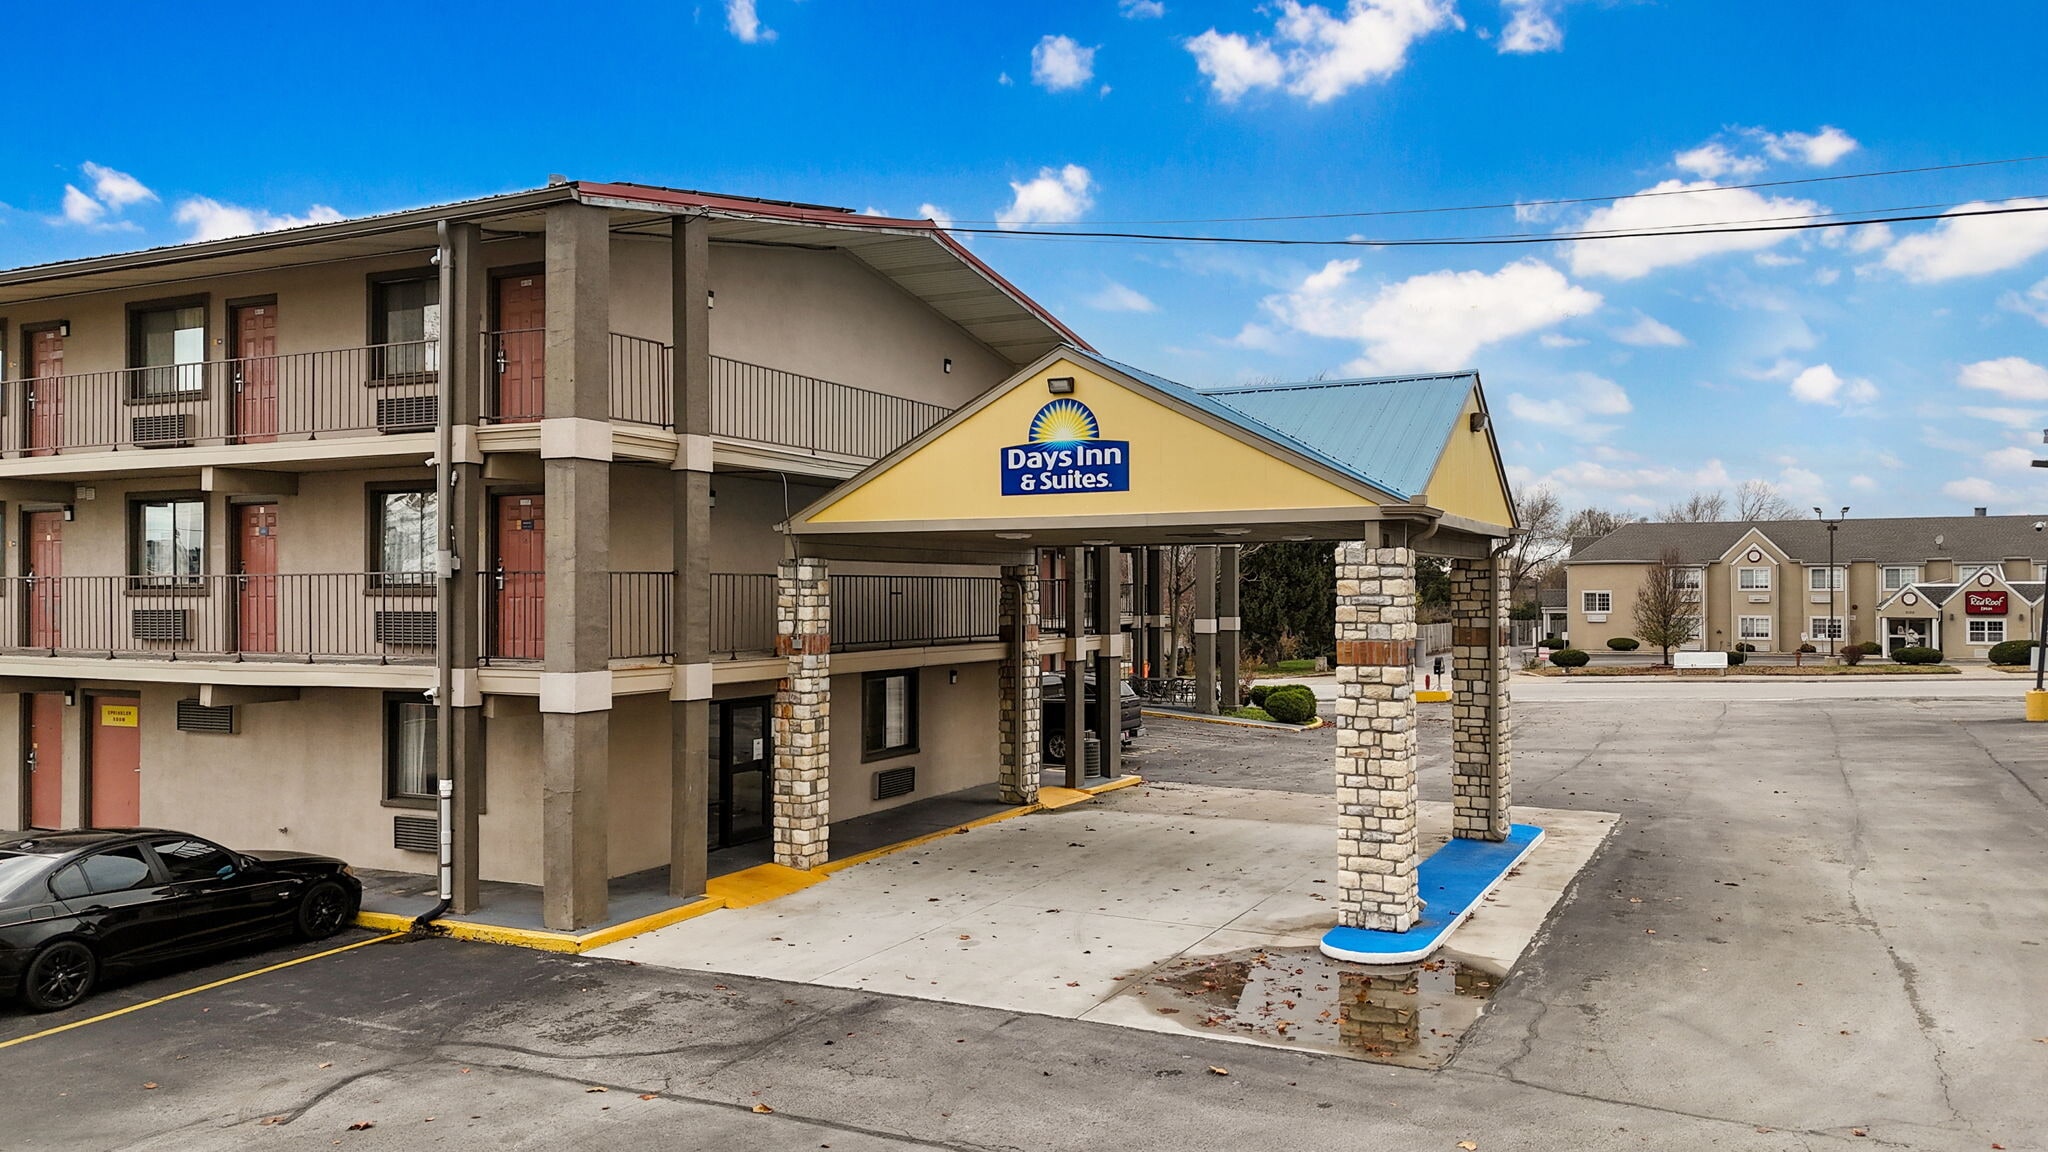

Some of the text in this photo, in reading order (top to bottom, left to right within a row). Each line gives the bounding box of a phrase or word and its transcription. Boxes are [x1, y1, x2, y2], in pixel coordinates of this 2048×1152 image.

[1008, 445, 1121, 471] Days Inn
[1020, 474, 1036, 491] &
[1970, 596, 2005, 606] Red Roof
